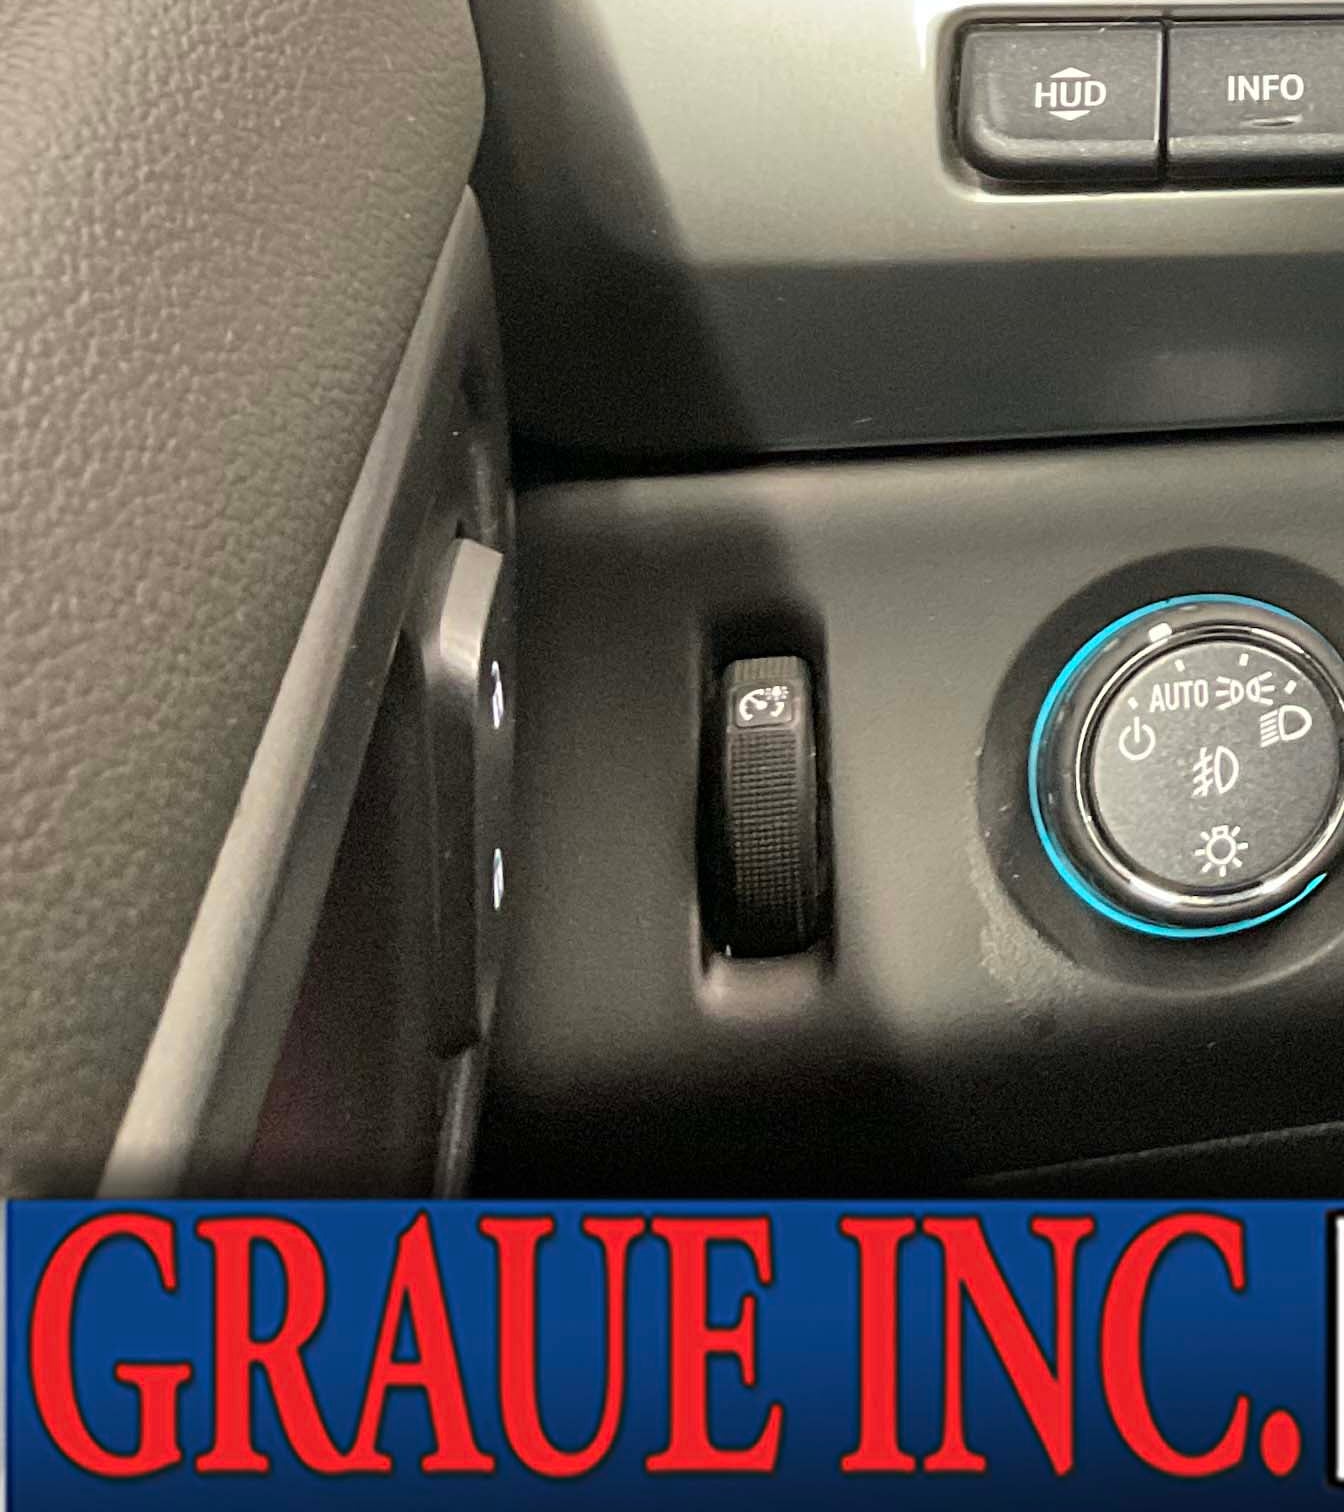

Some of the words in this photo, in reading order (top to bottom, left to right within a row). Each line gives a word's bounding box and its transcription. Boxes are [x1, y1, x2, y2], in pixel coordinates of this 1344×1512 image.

[1034, 80, 1107, 108] HUD
[1227, 74, 1304, 102] INFO
[1149, 679, 1209, 713] AUTO
